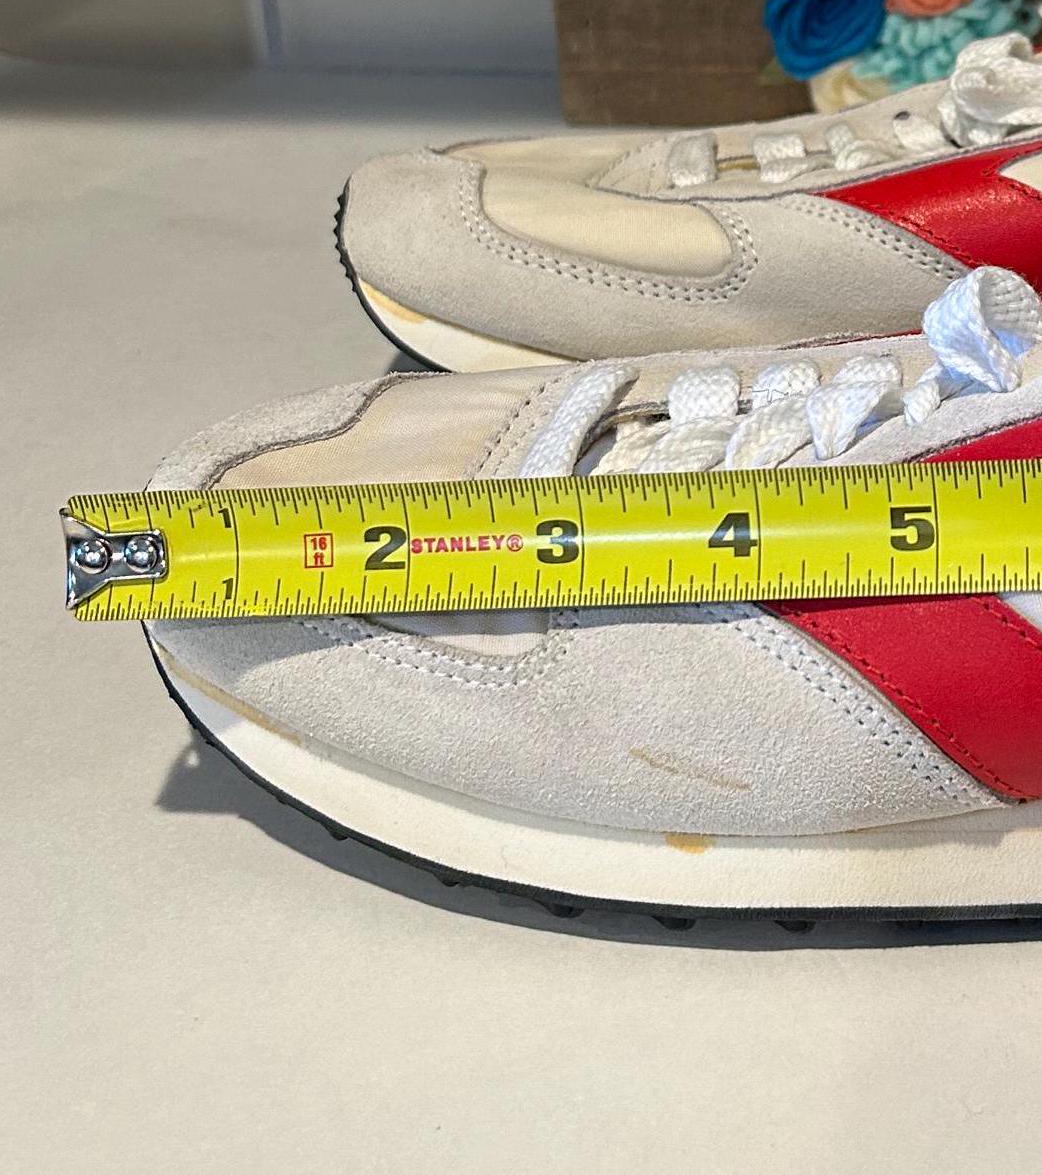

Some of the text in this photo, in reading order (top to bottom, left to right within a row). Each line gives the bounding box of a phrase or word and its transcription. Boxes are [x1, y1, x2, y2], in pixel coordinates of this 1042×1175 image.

[218, 508, 232, 528] 1
[889, 506, 935, 551] 5
[311, 537, 327, 551] 16
[364, 526, 407, 570] 2
[536, 520, 579, 564] 3
[708, 512, 758, 557] 4
[313, 552, 325, 566] ft
[222, 578, 234, 599] 1
